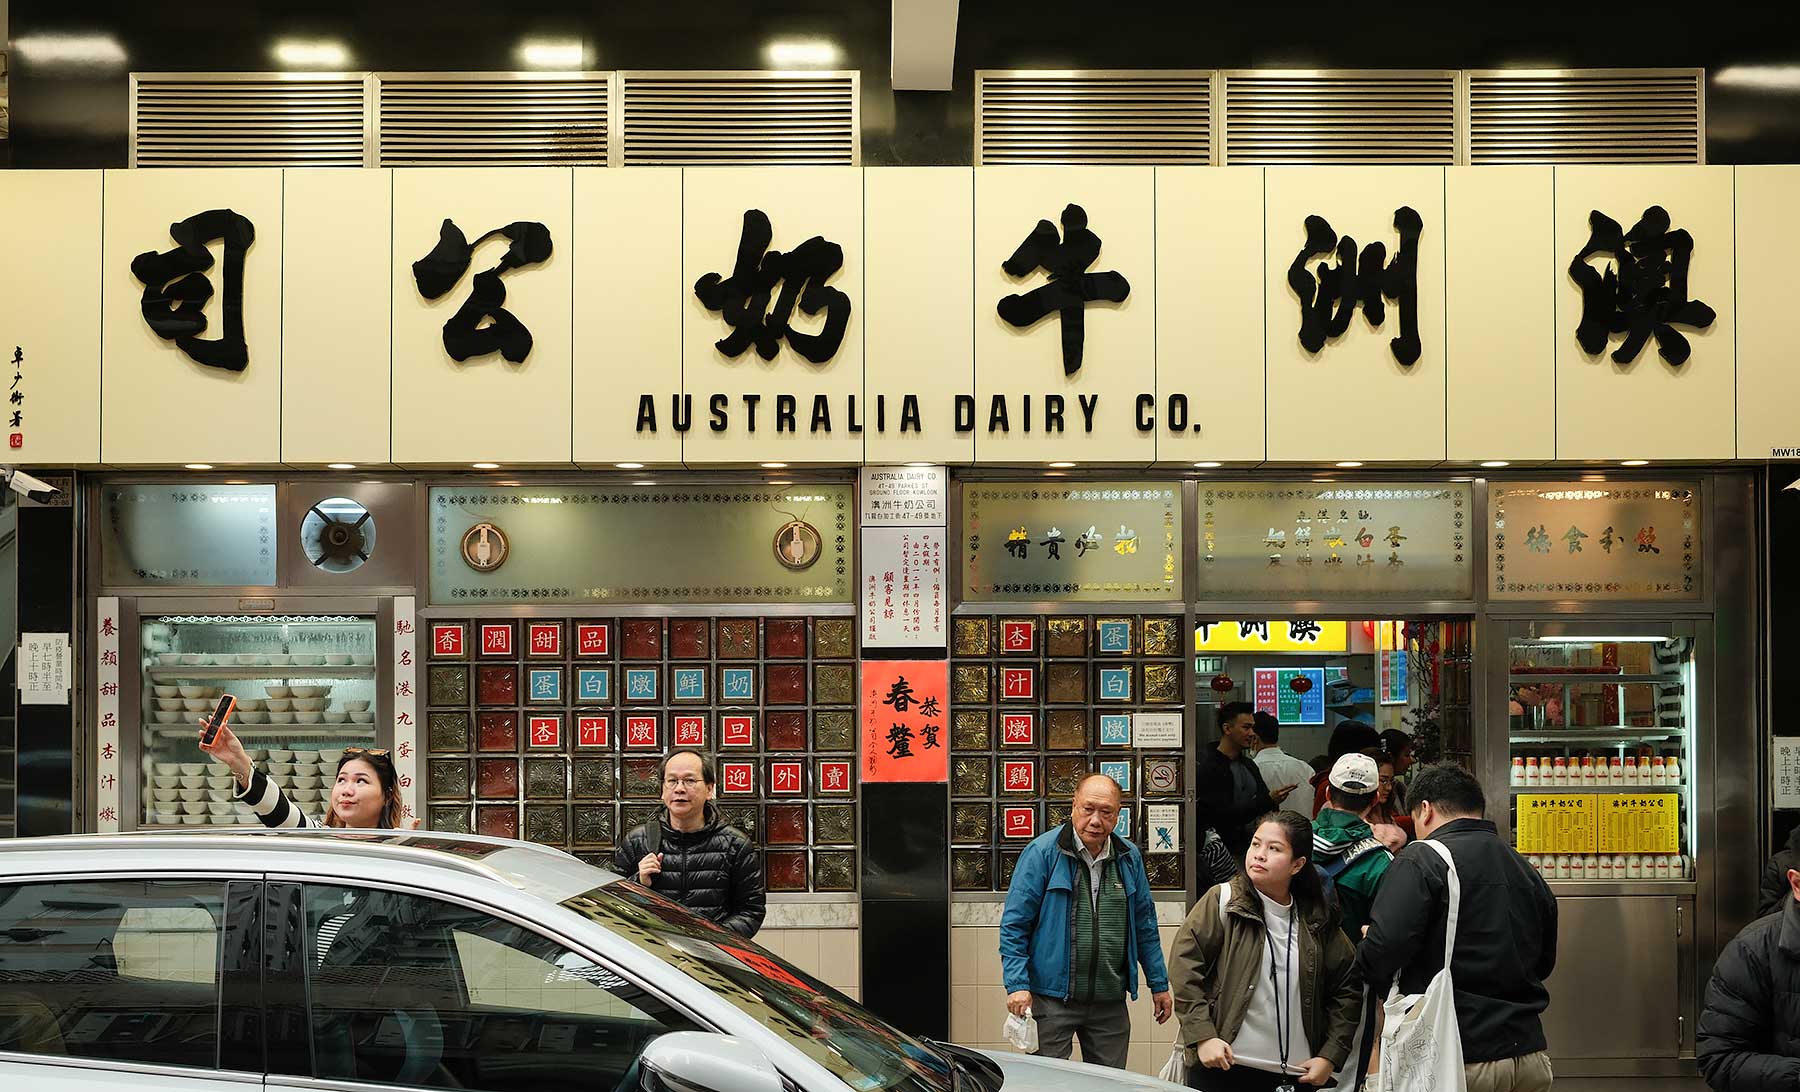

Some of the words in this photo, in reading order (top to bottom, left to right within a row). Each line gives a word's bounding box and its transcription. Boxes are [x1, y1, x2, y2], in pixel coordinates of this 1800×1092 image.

[130, 203, 1717, 377] 澳洲牛奶公司
[636, 393, 922, 433] AUSTRALIA
[954, 393, 1098, 433] DAIRY
[1135, 393, 1203, 433] CO.
[870, 472, 904, 481] AUSTRALIA
[906, 472, 924, 481] DAIRY
[871, 499, 936, 510] 澳洲牛奶公司
[437, 627, 604, 651] 香潤甜品
[28, 642, 39, 692] 晚上十時正
[533, 672, 750, 697] 蛋白燉鮮奶
[919, 695, 942, 750] 恭賀
[726, 766, 844, 789] 迎外賣
[1780, 746, 1791, 796] 晚上十時正
[1531, 799, 1583, 808] 澳洲牛奶公司
[1612, 799, 1664, 808] 澳洲牛奶公司
